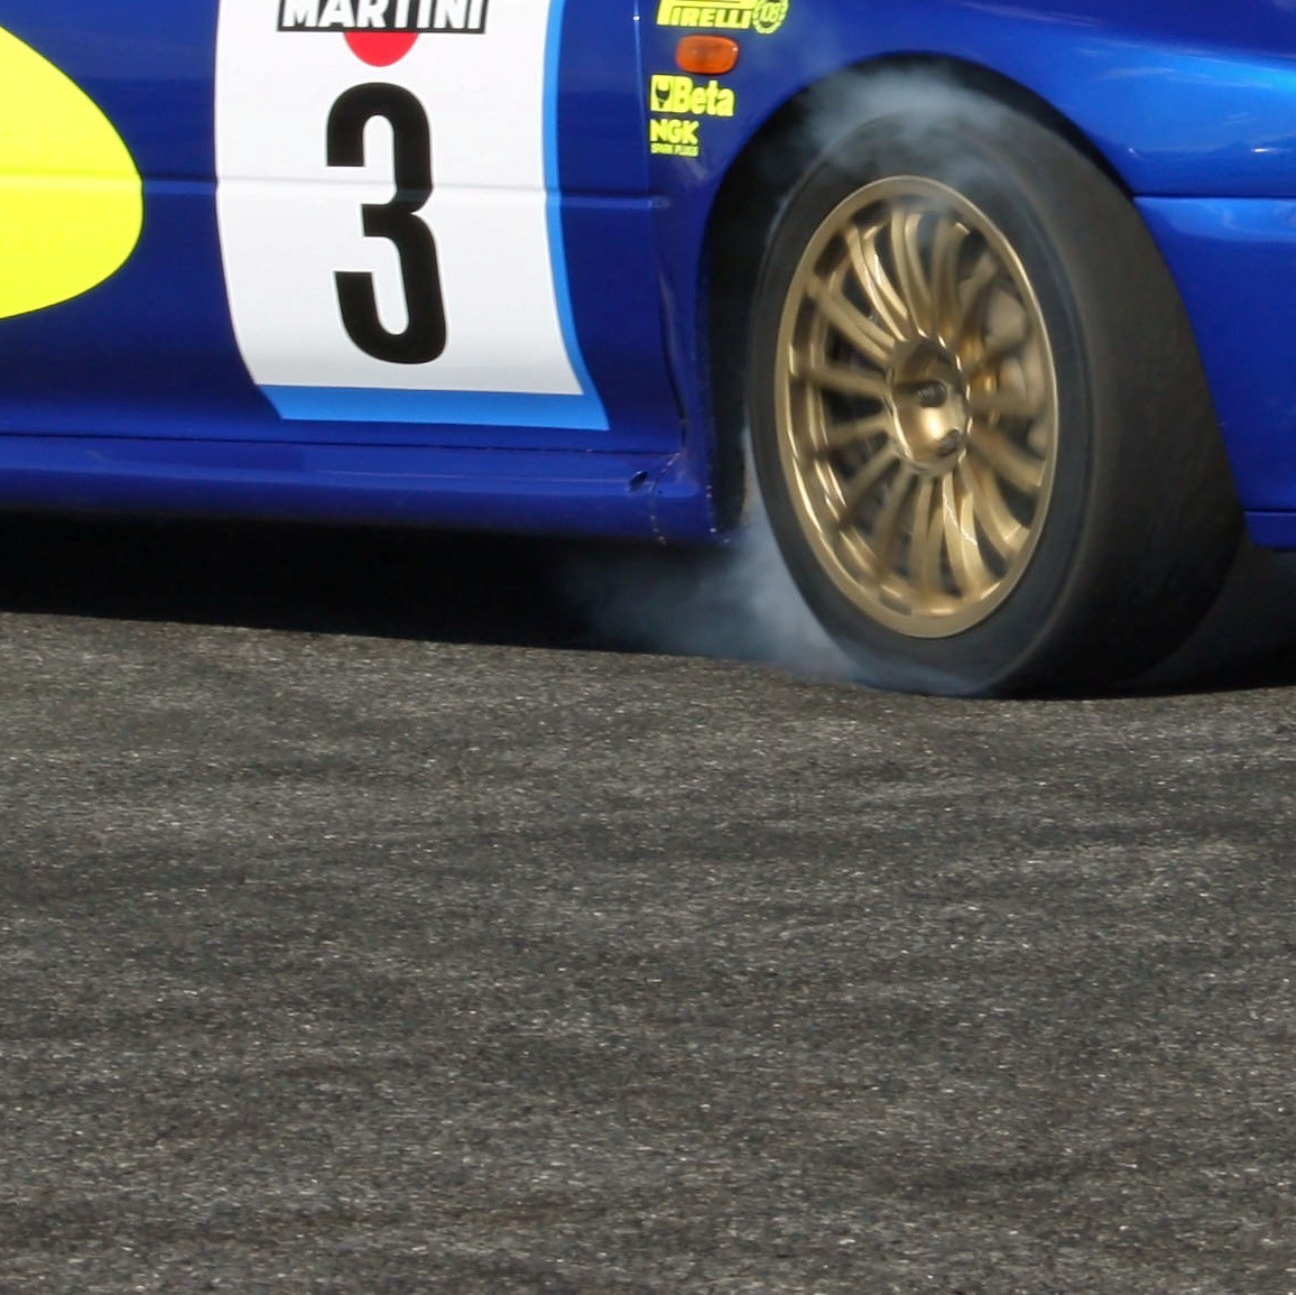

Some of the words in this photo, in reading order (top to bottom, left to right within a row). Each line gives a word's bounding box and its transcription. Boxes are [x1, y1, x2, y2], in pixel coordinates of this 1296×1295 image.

[672, 75, 735, 117] Beta
[649, 118, 700, 145] NGK
[326, 82, 447, 364] 3
